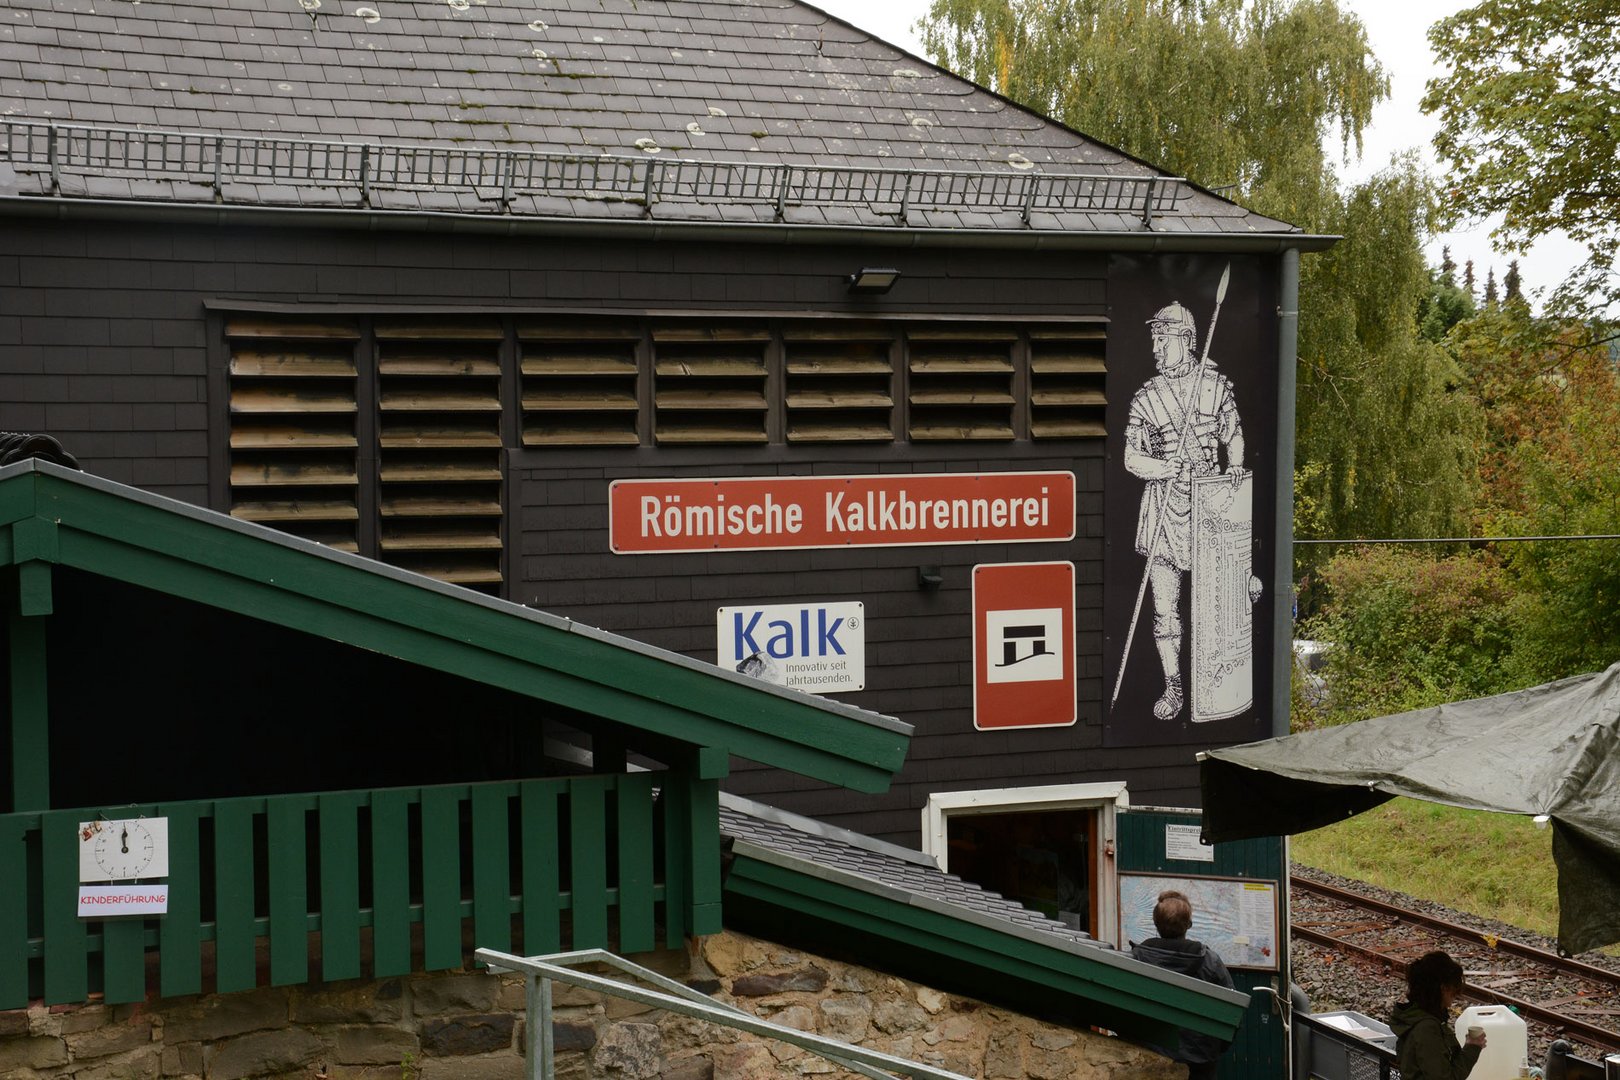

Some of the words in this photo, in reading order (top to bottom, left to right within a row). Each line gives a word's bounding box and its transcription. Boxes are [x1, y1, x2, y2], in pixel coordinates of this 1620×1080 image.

[641, 493, 803, 537] Römische
[826, 487, 1049, 532] Kalkbrennerei
[734, 608, 847, 660] Kalk
[786, 663, 828, 673] Innovativ
[830, 660, 847, 670] seit
[786, 672, 853, 687] Jahrtausenden.
[80, 894, 166, 904] KINDERFÜHRUNG
